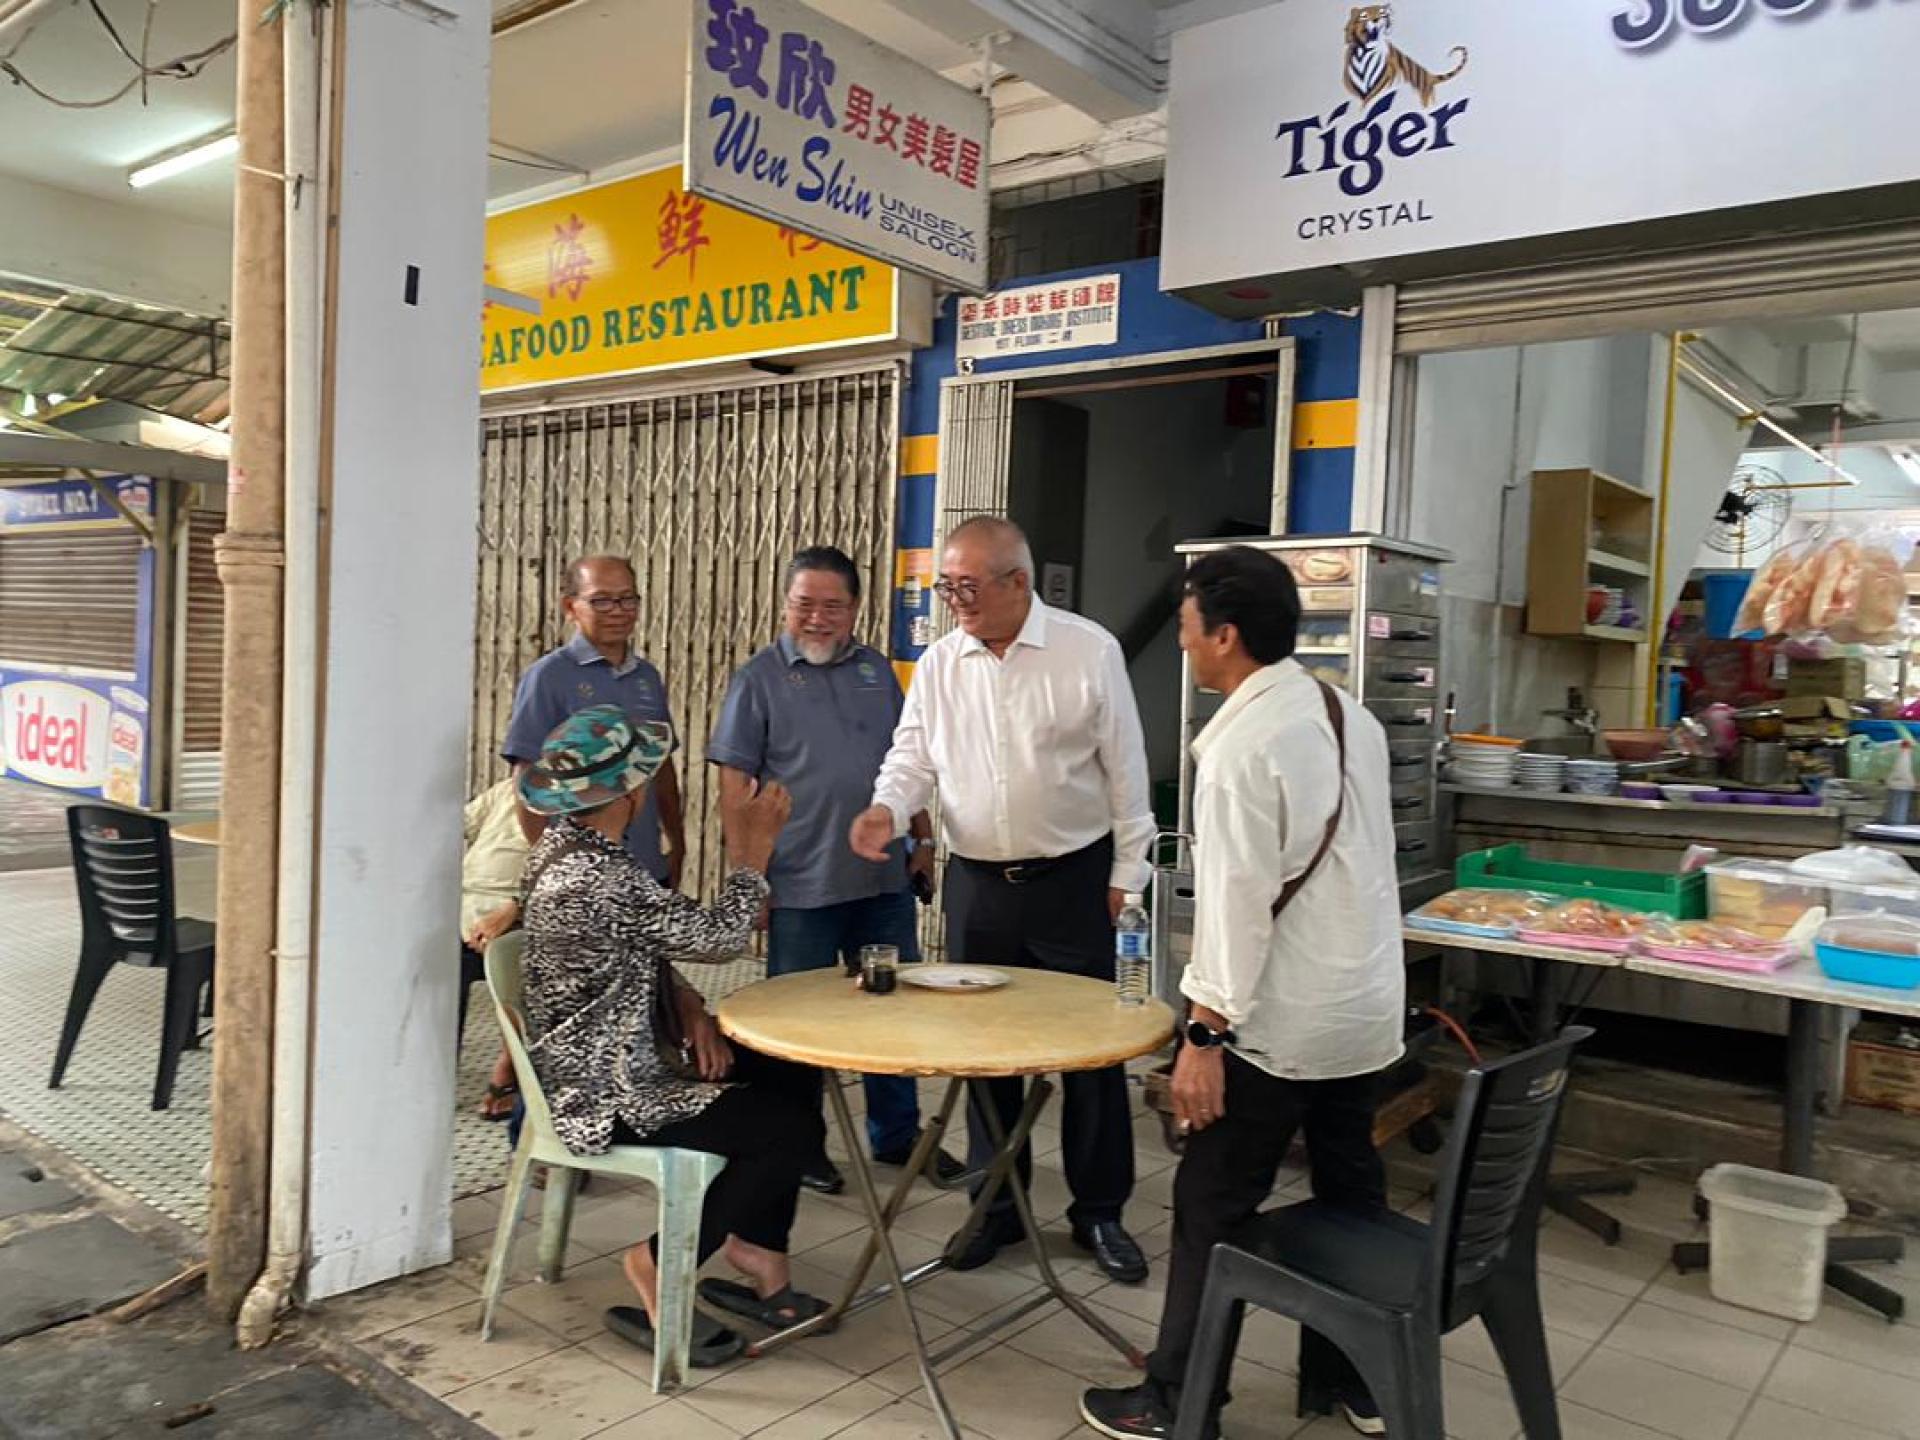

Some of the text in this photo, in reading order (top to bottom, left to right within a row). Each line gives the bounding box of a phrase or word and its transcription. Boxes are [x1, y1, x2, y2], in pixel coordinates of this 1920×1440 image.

[709, 94, 872, 220] Wen Shin
[842, 84, 981, 189] 男女美髮屋
[1276, 90, 1469, 196] Tiger
[879, 214, 977, 264] SALOON
[880, 193, 977, 244] UNISEX
[1298, 199, 1432, 240] CRYSTAL
[481, 265, 866, 368] AFOOD RESTAURANT
[16, 693, 88, 773] ideal
